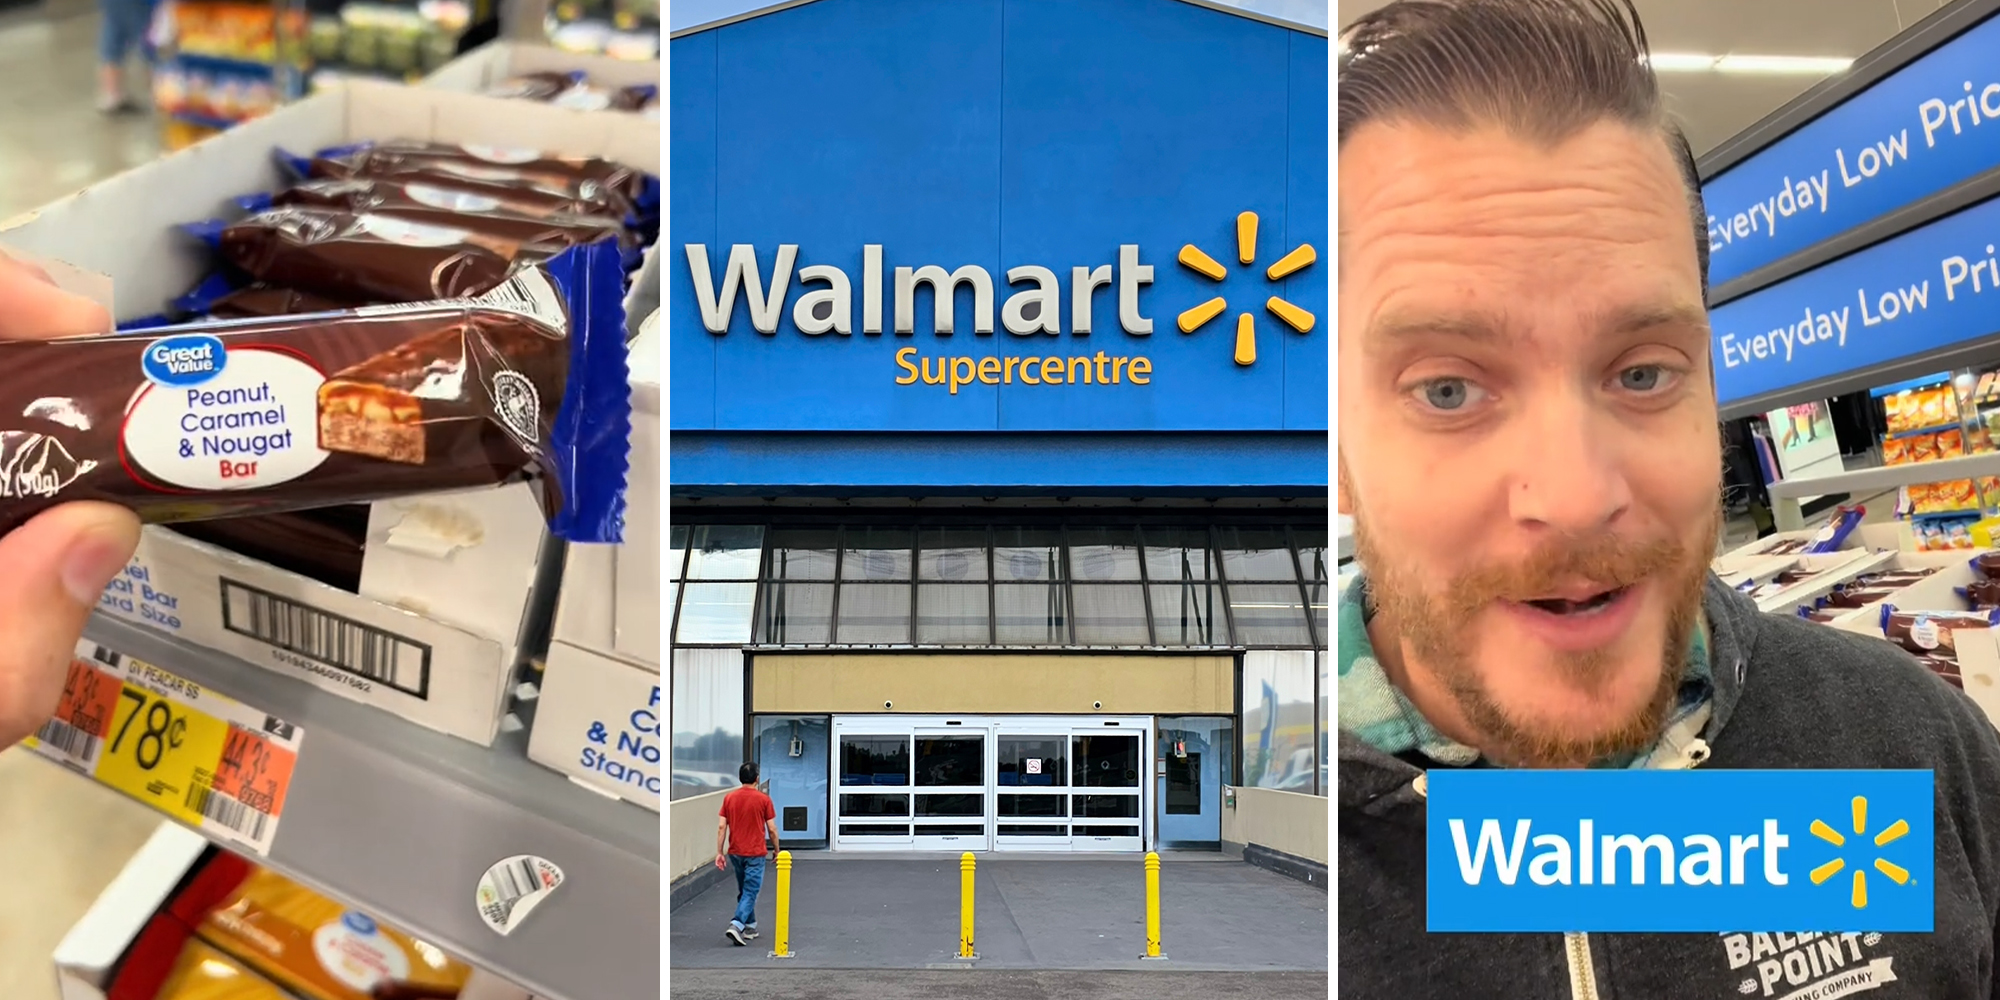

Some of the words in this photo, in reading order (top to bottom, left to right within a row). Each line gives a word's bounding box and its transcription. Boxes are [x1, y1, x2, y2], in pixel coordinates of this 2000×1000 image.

[1708, 169, 1828, 252] Everyday
[1836, 128, 1907, 188] Low
[1919, 80, 2000, 148] Pric
[685, 243, 1154, 336] Walmart
[1721, 306, 1849, 368] Everyday
[1858, 280, 1929, 327] Low
[1942, 244, 2000, 301] Pri
[152, 343, 213, 364] Great
[167, 359, 213, 375] Value
[894, 347, 1152, 394] Supercentre
[187, 382, 276, 409] Peanut,
[180, 404, 285, 432] Caramel
[178, 438, 195, 458] &
[202, 428, 292, 456] Nougat
[219, 459, 258, 478] Bar
[142, 583, 178, 609] Bar
[140, 602, 181, 628] Size
[185, 682, 200, 699] SS
[111, 686, 187, 770] 78¢
[273, 719, 285, 735] 2
[630, 709, 660, 738] C
[586, 720, 608, 744] &
[617, 730, 660, 763] No
[1757, 931, 1863, 997] POINT
[1822, 971, 1873, 997] COMPANY
